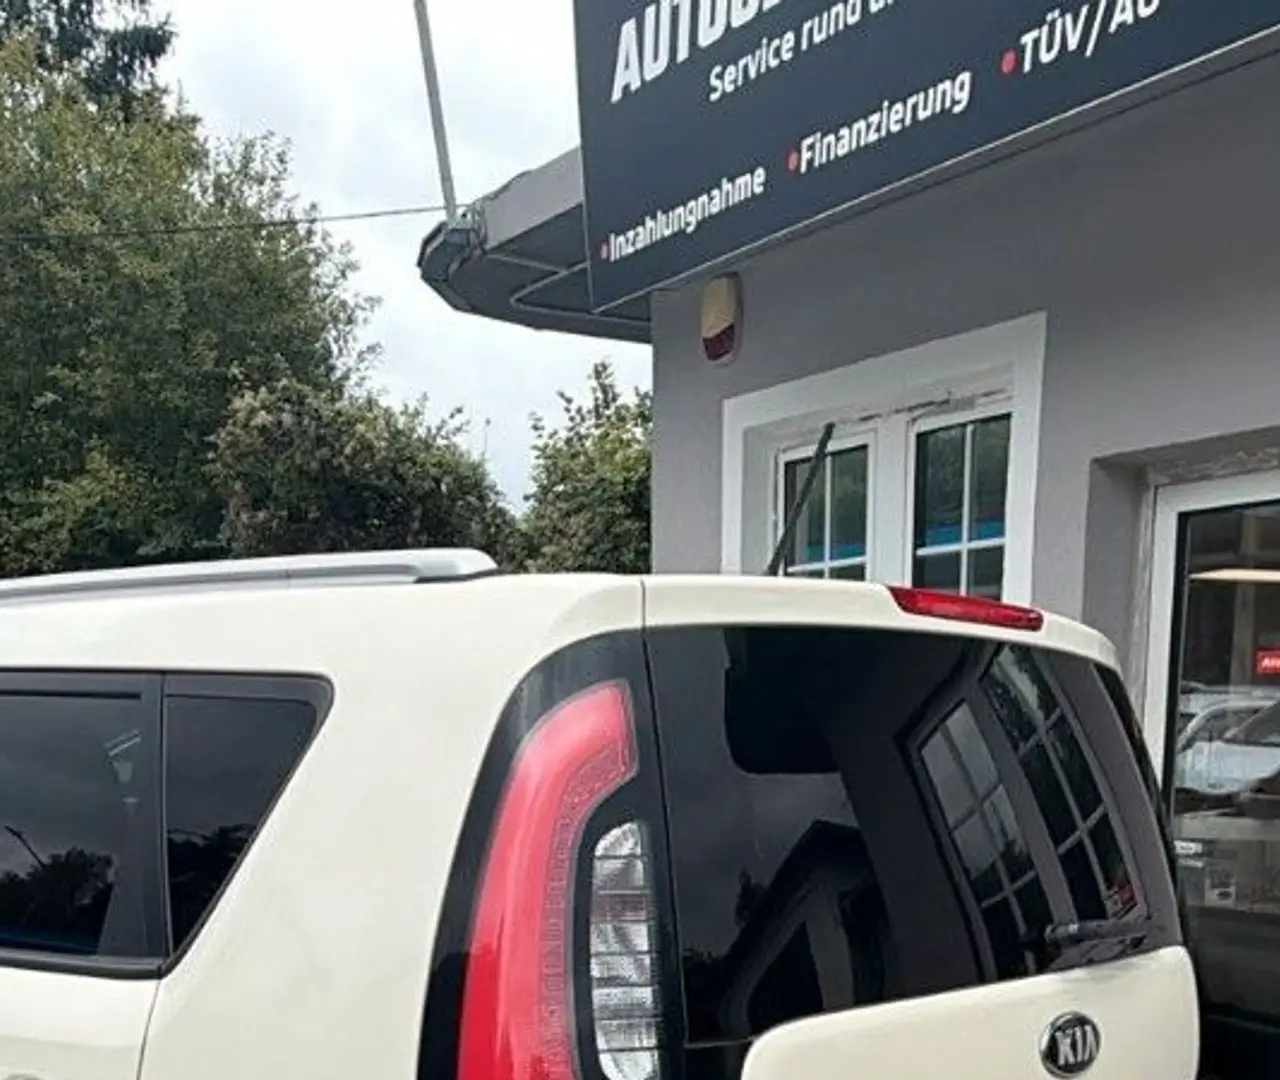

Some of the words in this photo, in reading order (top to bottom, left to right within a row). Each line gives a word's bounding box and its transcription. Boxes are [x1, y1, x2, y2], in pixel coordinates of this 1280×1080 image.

[611, 0, 781, 103] AUTO
[709, 30, 795, 102] Service
[609, 166, 766, 263] Inzahlungnahme
[800, 71, 972, 174] Finanzierung
[1054, 1024, 1098, 1066] KIA
